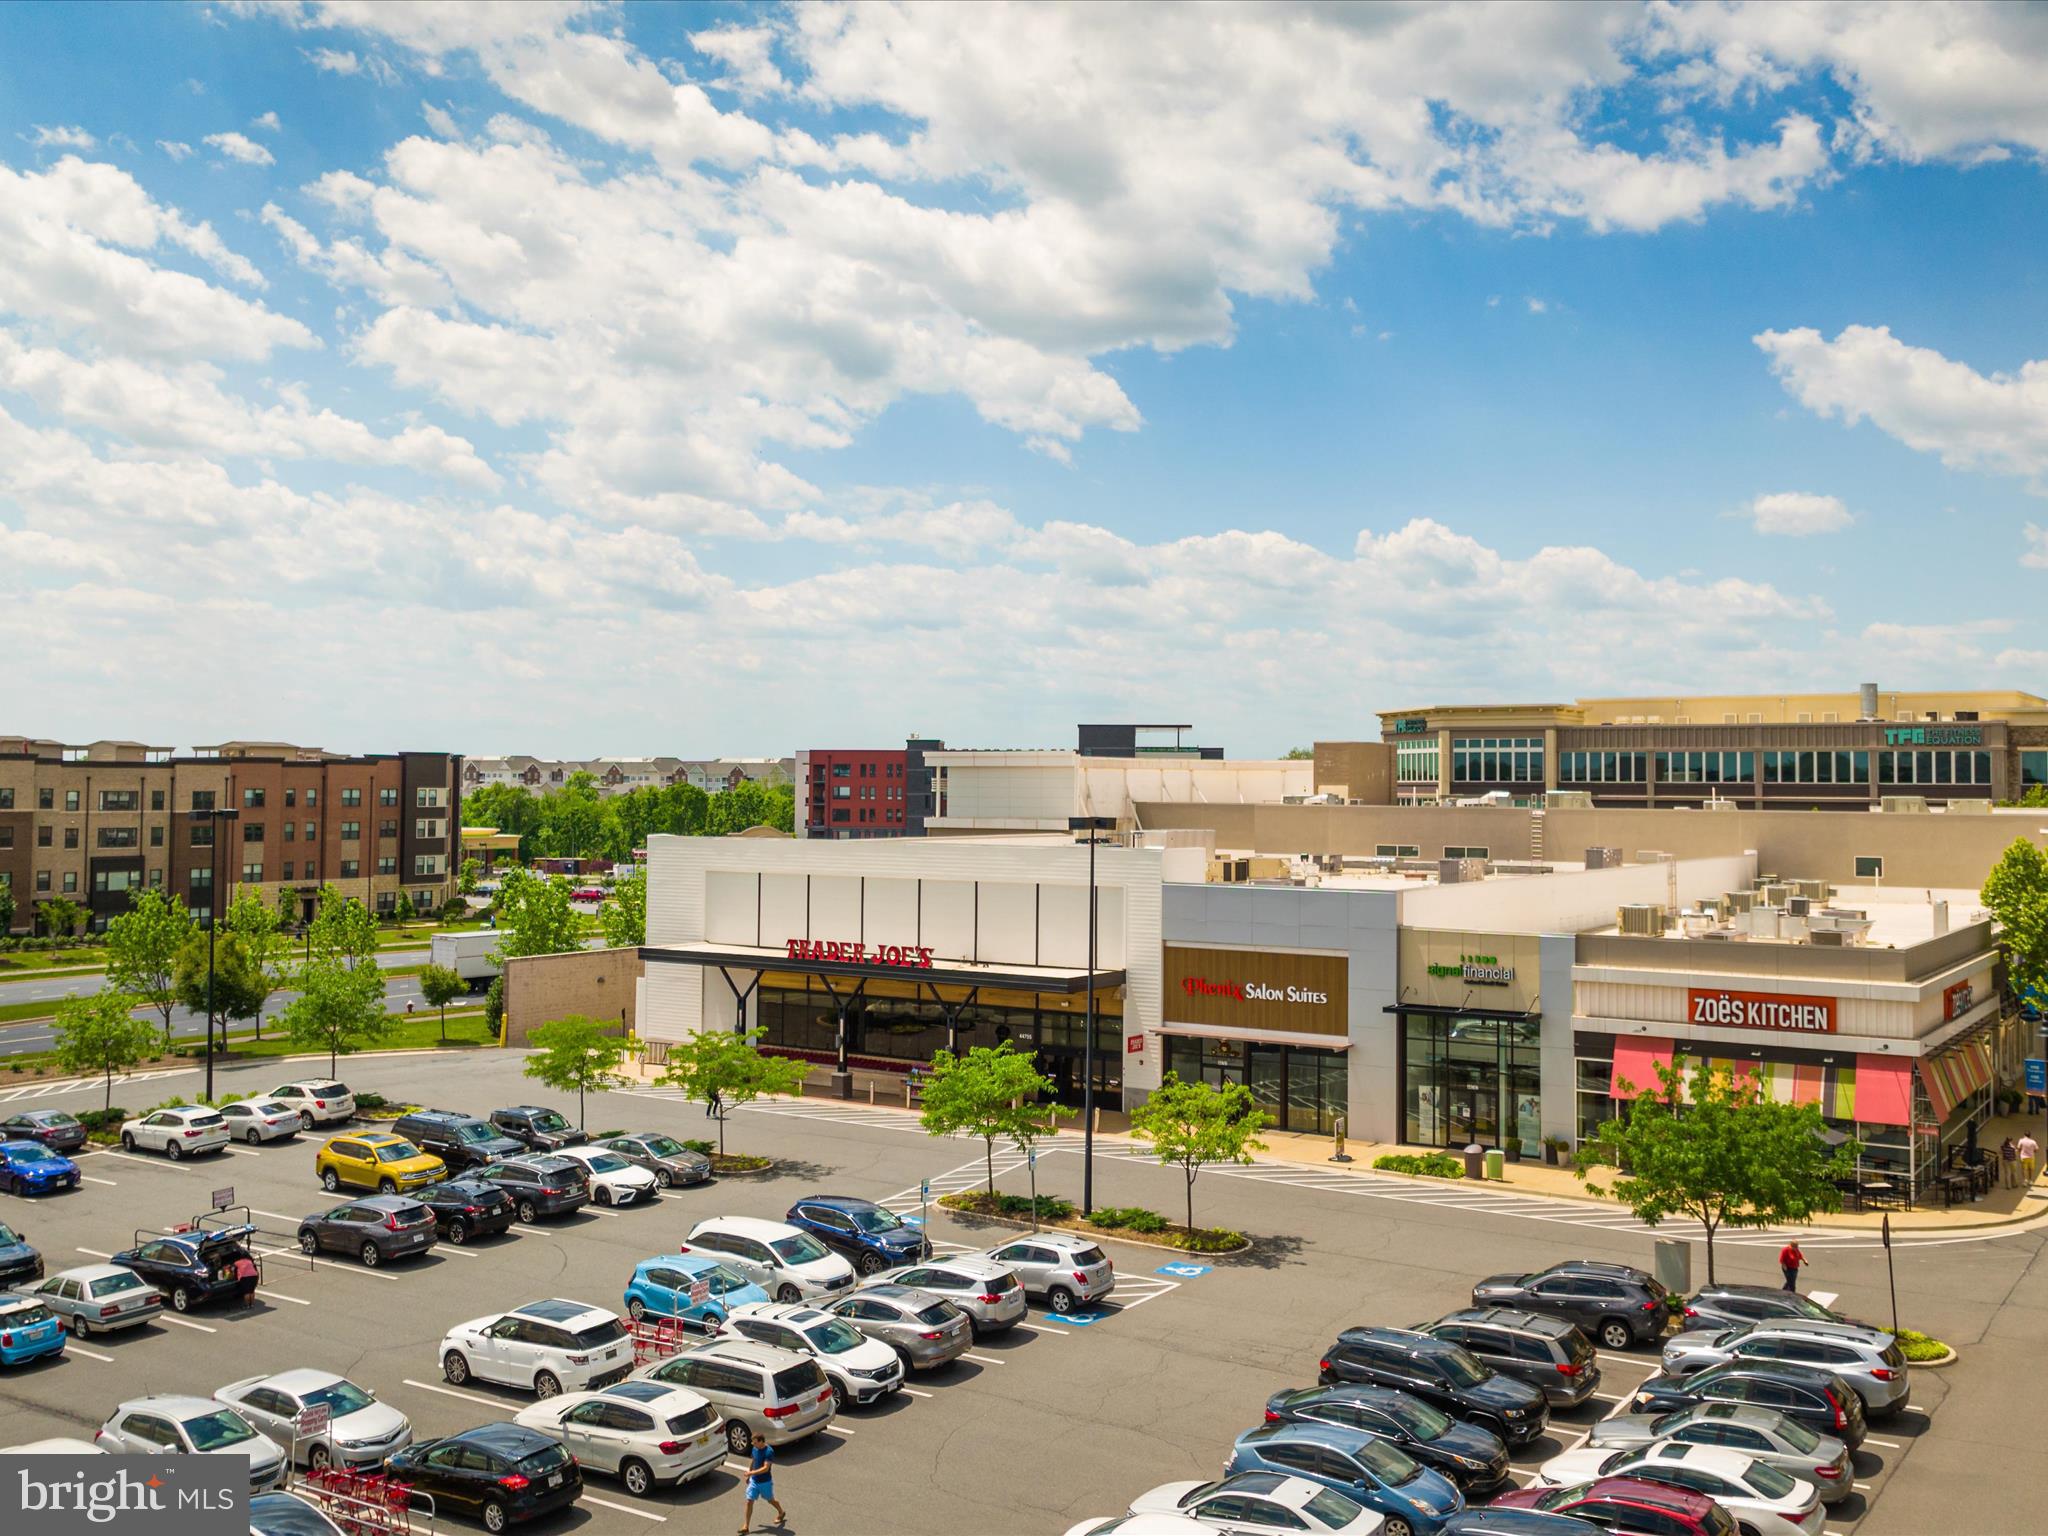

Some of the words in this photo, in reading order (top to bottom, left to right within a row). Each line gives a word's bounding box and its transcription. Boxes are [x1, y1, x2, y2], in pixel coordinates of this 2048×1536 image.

[1926, 737, 1980, 745] EQUATION
[786, 939, 866, 964] TRADER
[871, 944, 935, 969] JOE'S
[1181, 975, 1244, 1003] Phenix
[1747, 1002, 1828, 1030] KITCHEN
